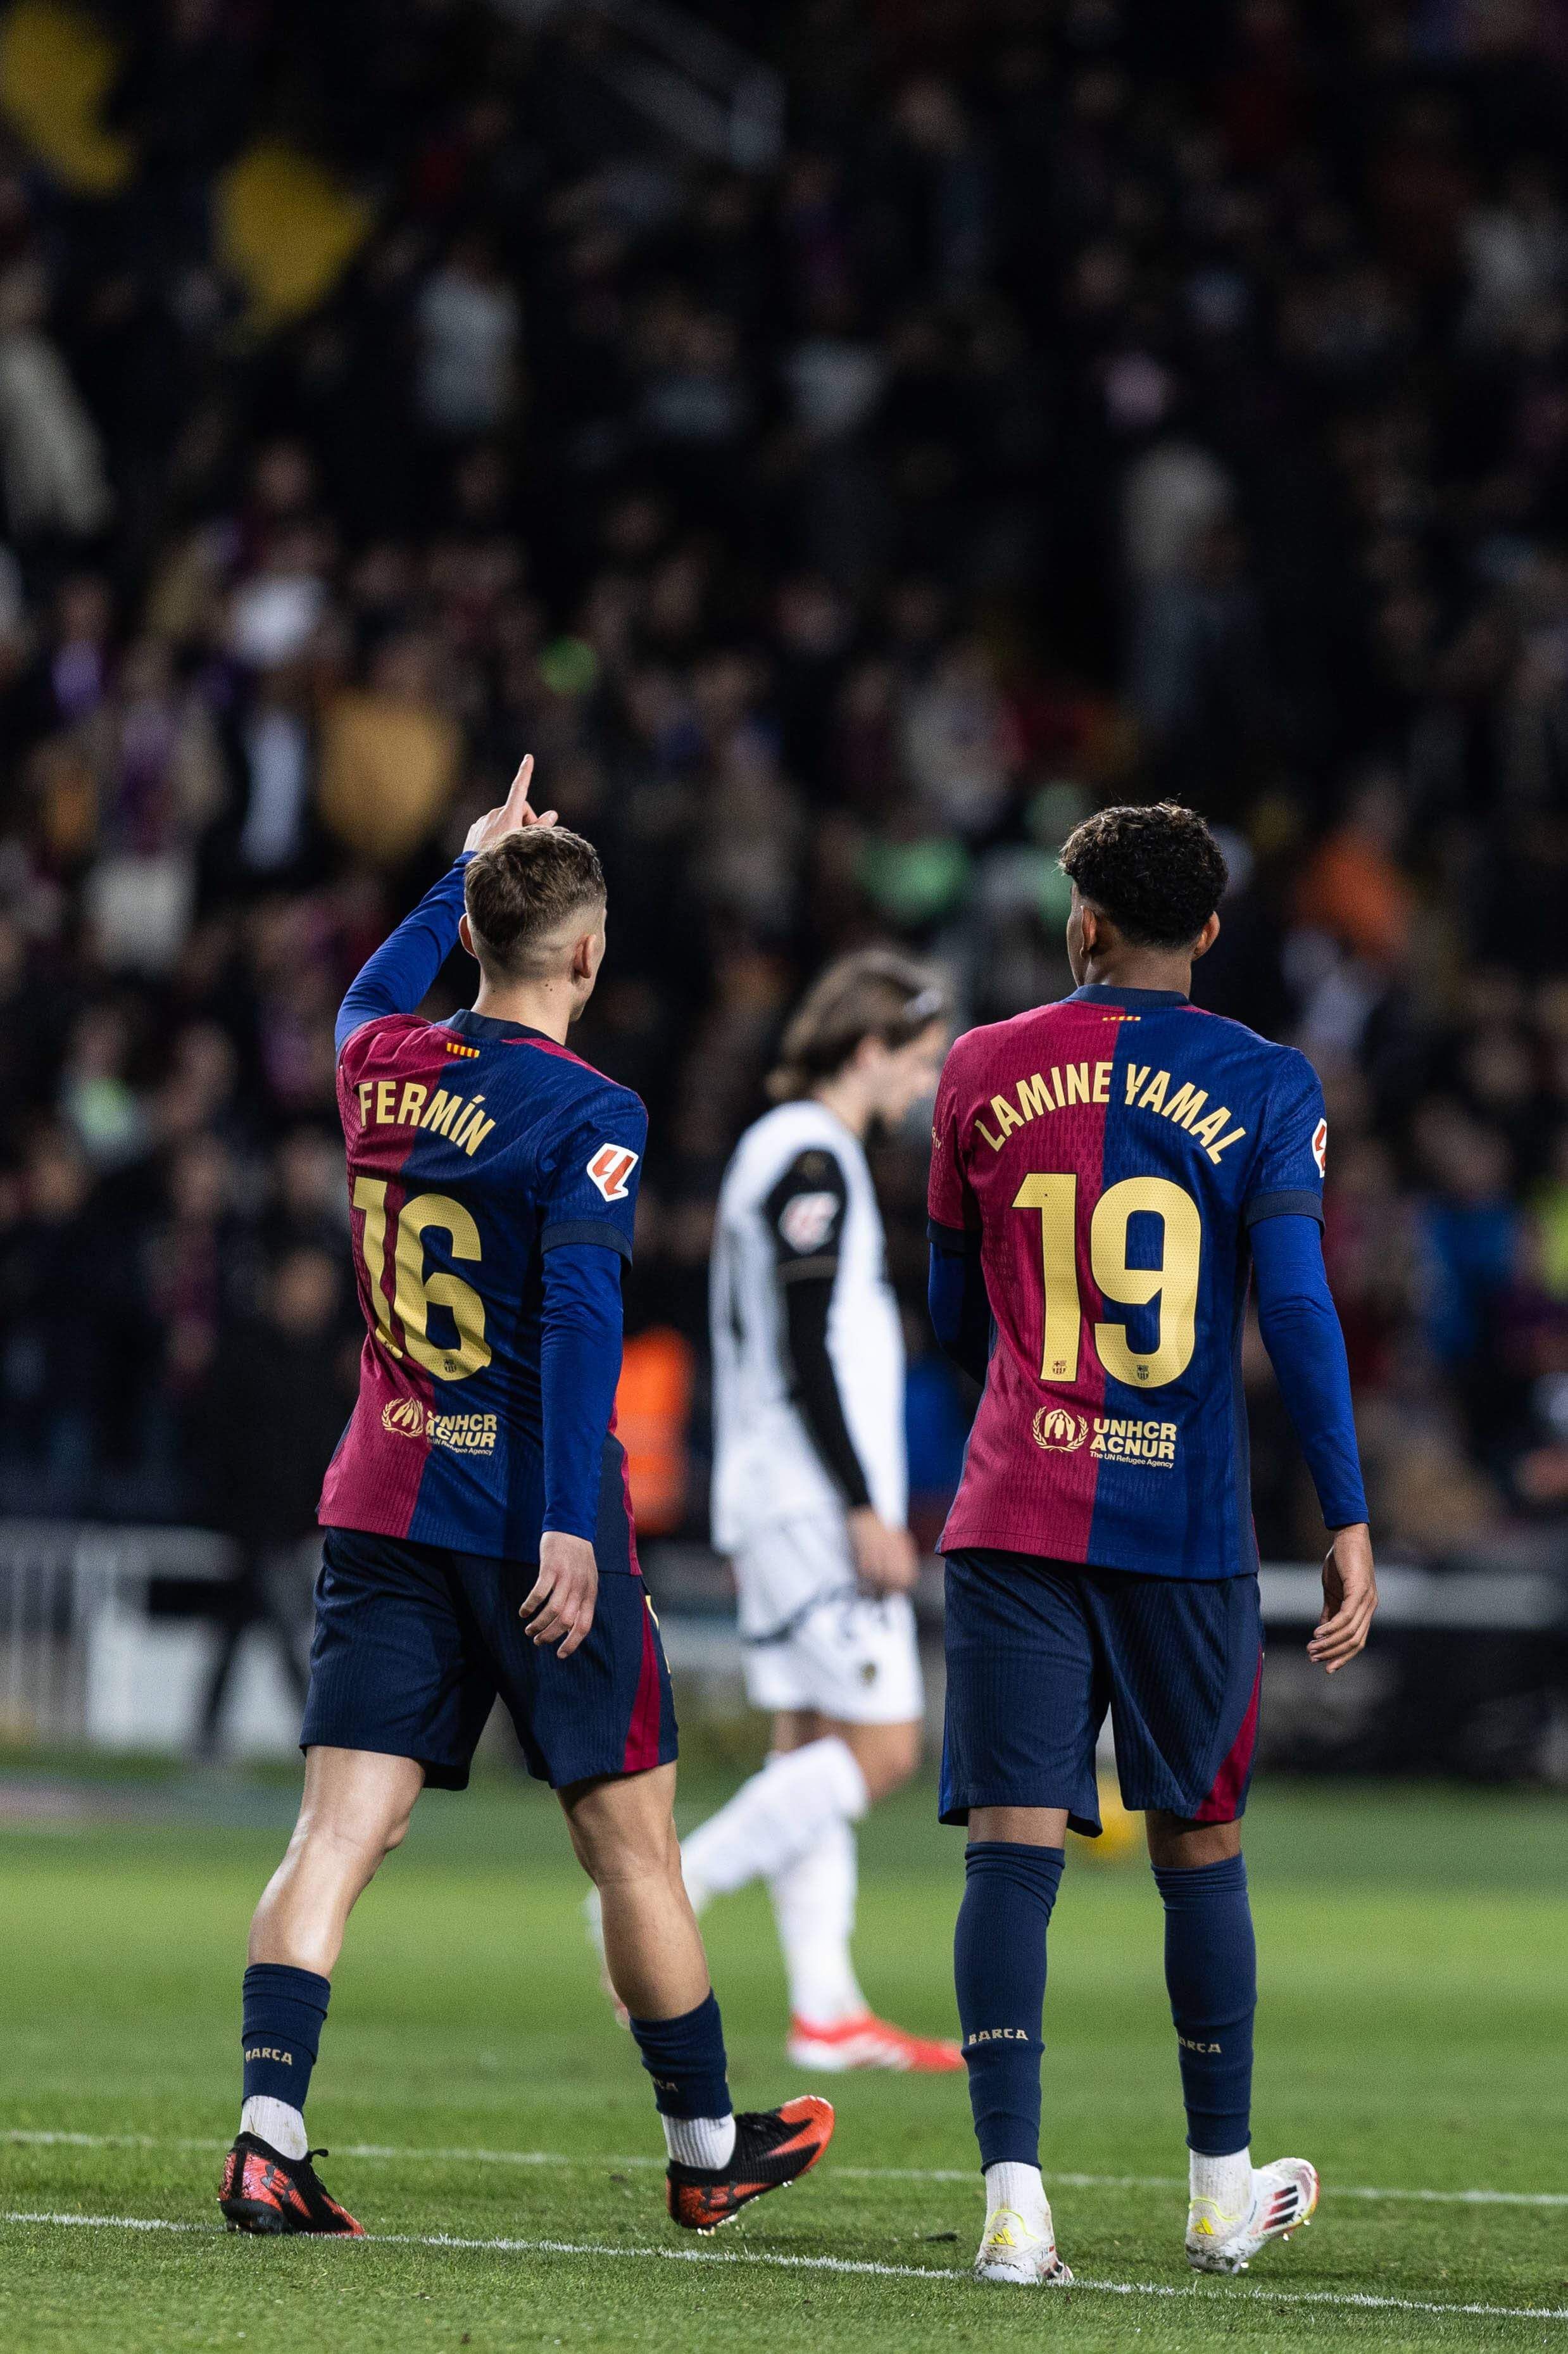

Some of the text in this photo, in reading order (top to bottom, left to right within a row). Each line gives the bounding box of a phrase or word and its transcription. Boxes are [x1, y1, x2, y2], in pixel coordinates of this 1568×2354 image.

[359, 1081, 496, 1157] FERMÍN
[975, 1062, 1246, 1165] LAMINE YAMAL
[353, 1176, 492, 1381] 16
[1012, 1173, 1201, 1388] 19
[1093, 1418, 1177, 1441] UNHCR
[468, 1447, 494, 1456] Agency
[1089, 1434, 1176, 1460] ACNUR
[1089, 1451, 1174, 1470] The UN Refugee Agency
[969, 2029, 1029, 2045] BARCA
[1179, 2036, 1222, 2053] ARCA
